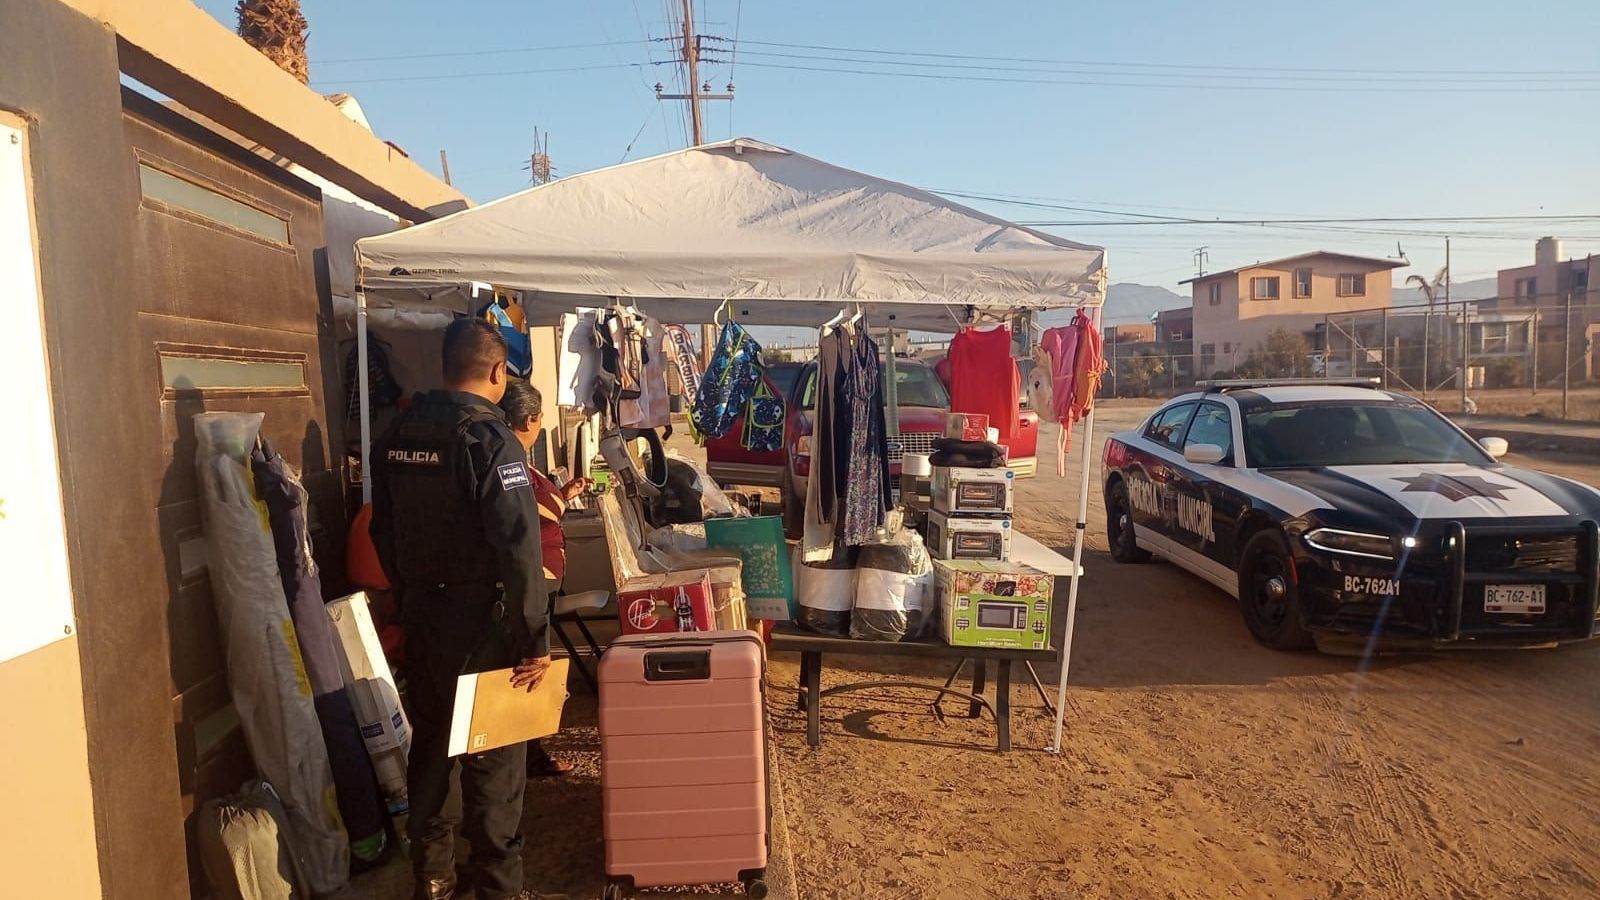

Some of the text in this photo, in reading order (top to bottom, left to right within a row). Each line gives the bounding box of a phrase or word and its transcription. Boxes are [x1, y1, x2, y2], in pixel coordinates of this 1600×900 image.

[388, 450, 439, 463] POLICIA
[1344, 575, 1400, 596] BC-762A1
[1487, 589, 1543, 603] BC-762-A1
